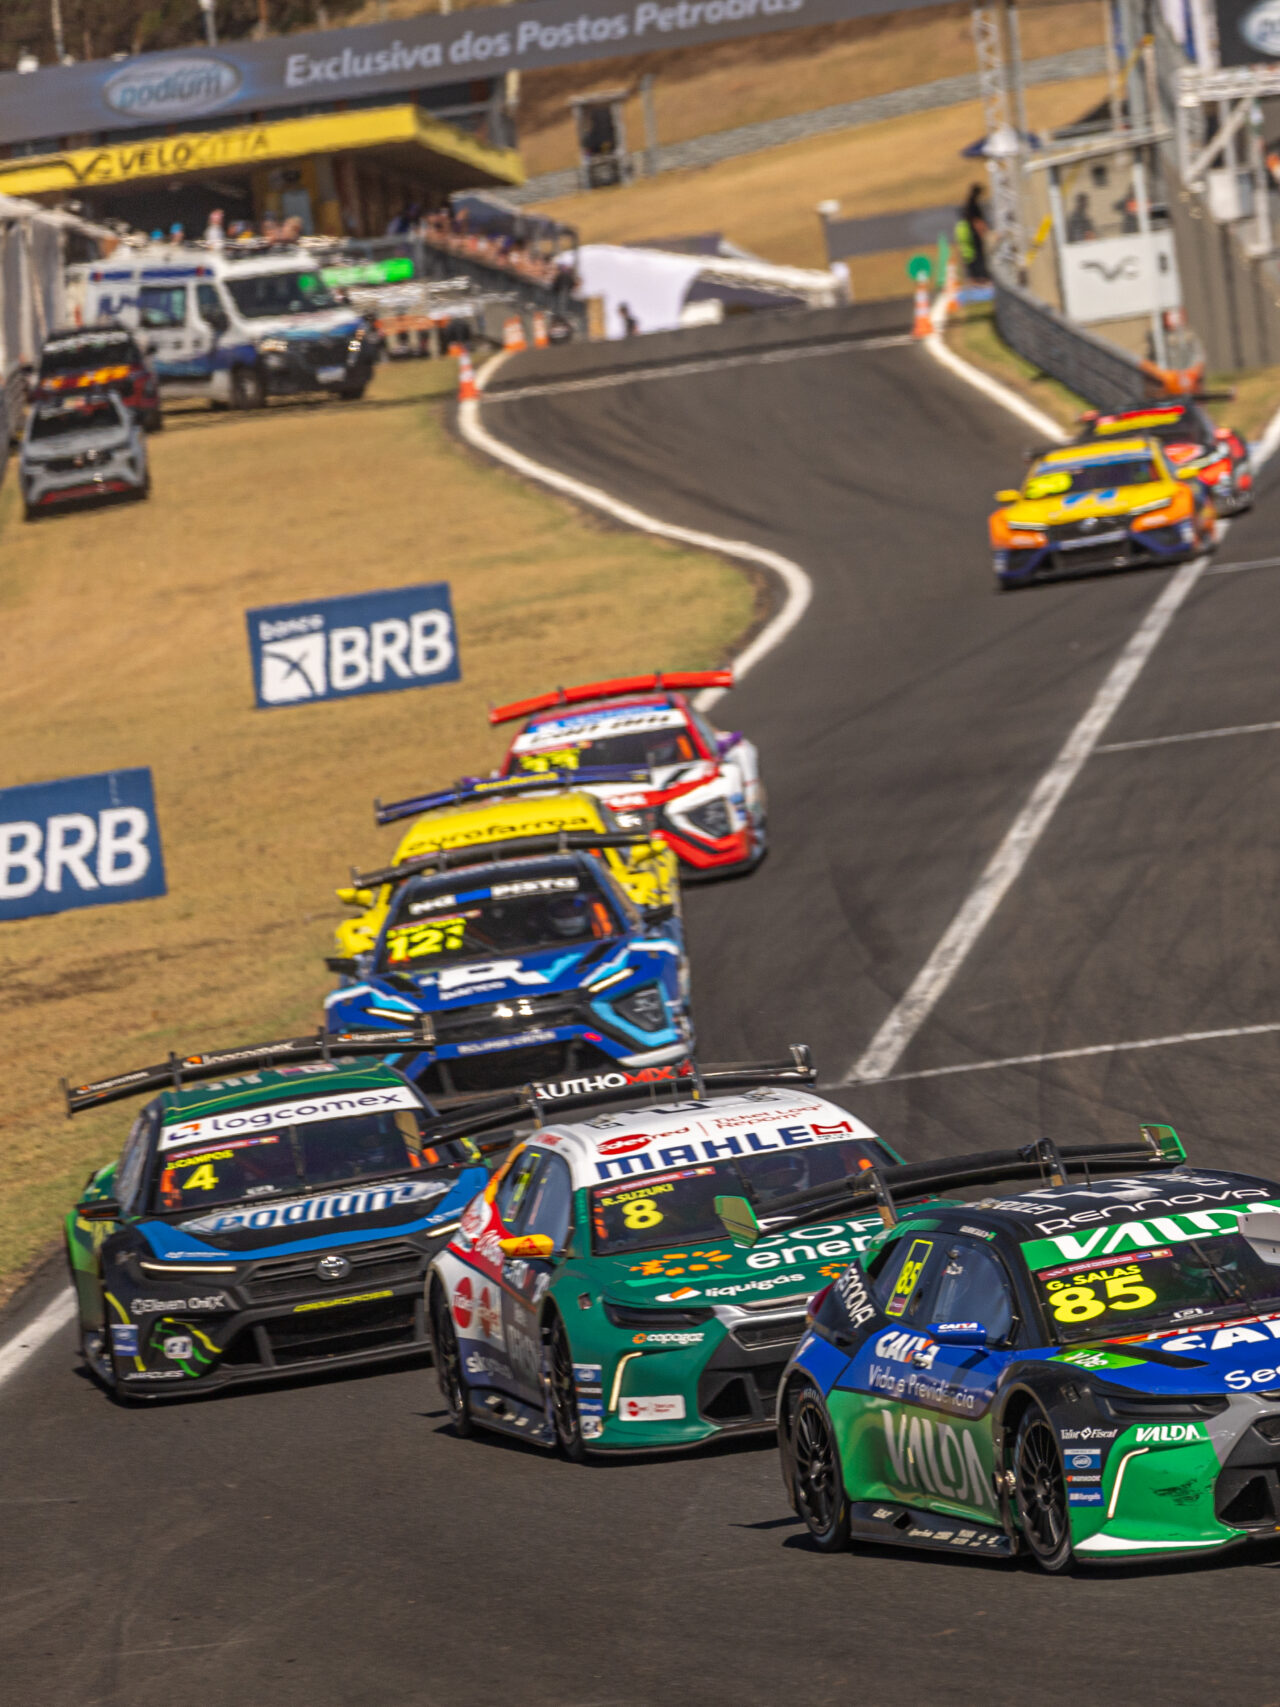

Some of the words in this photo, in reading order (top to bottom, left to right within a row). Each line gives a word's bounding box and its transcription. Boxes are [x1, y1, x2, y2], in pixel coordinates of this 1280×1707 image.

[284, 40, 443, 88] Exclusiva
[450, 31, 512, 65] dos
[517, 14, 629, 53] Postos
[329, 608, 455, 691] BRB
[0, 806, 151, 900] BRB
[211, 1090, 403, 1131] logcomex
[594, 1125, 814, 1180] MAHLE
[182, 1163, 219, 1190] 4
[622, 1198, 664, 1230] 8
[895, 1260, 923, 1295] 85
[1046, 1280, 1072, 1291] G.
[1073, 1264, 1142, 1286] SALAS
[1048, 1273, 1157, 1323] 85
[875, 1331, 941, 1370] CAIXA
[868, 1364, 895, 1390] Vida
[897, 1378, 905, 1393] e
[1091, 1428, 1119, 1439] Fiscal
[1136, 1424, 1200, 1442] VALDA
[881, 1408, 996, 1510] VALDA
